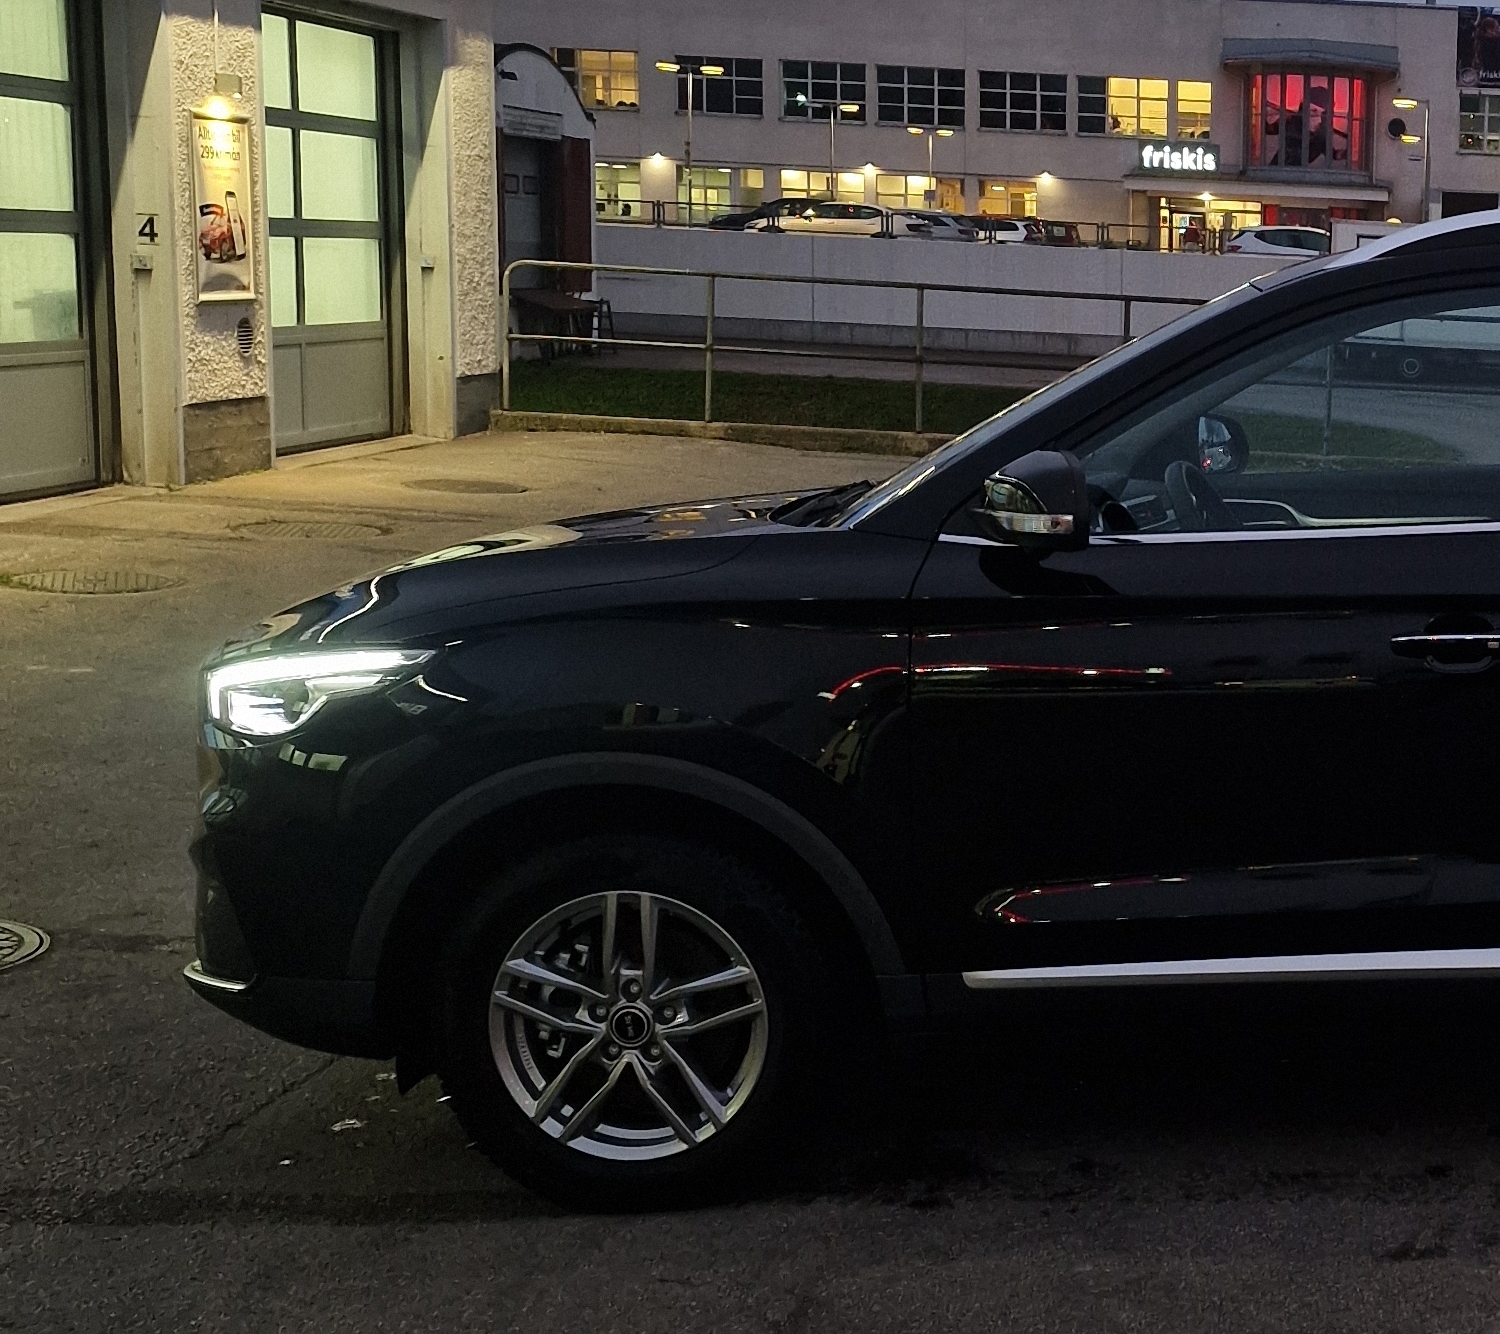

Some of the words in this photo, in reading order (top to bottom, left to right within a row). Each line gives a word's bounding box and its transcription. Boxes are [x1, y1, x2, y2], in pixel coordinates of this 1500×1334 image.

[200, 145, 215, 159] 299
[1141, 144, 1217, 171] friskis
[138, 216, 159, 243] 4
